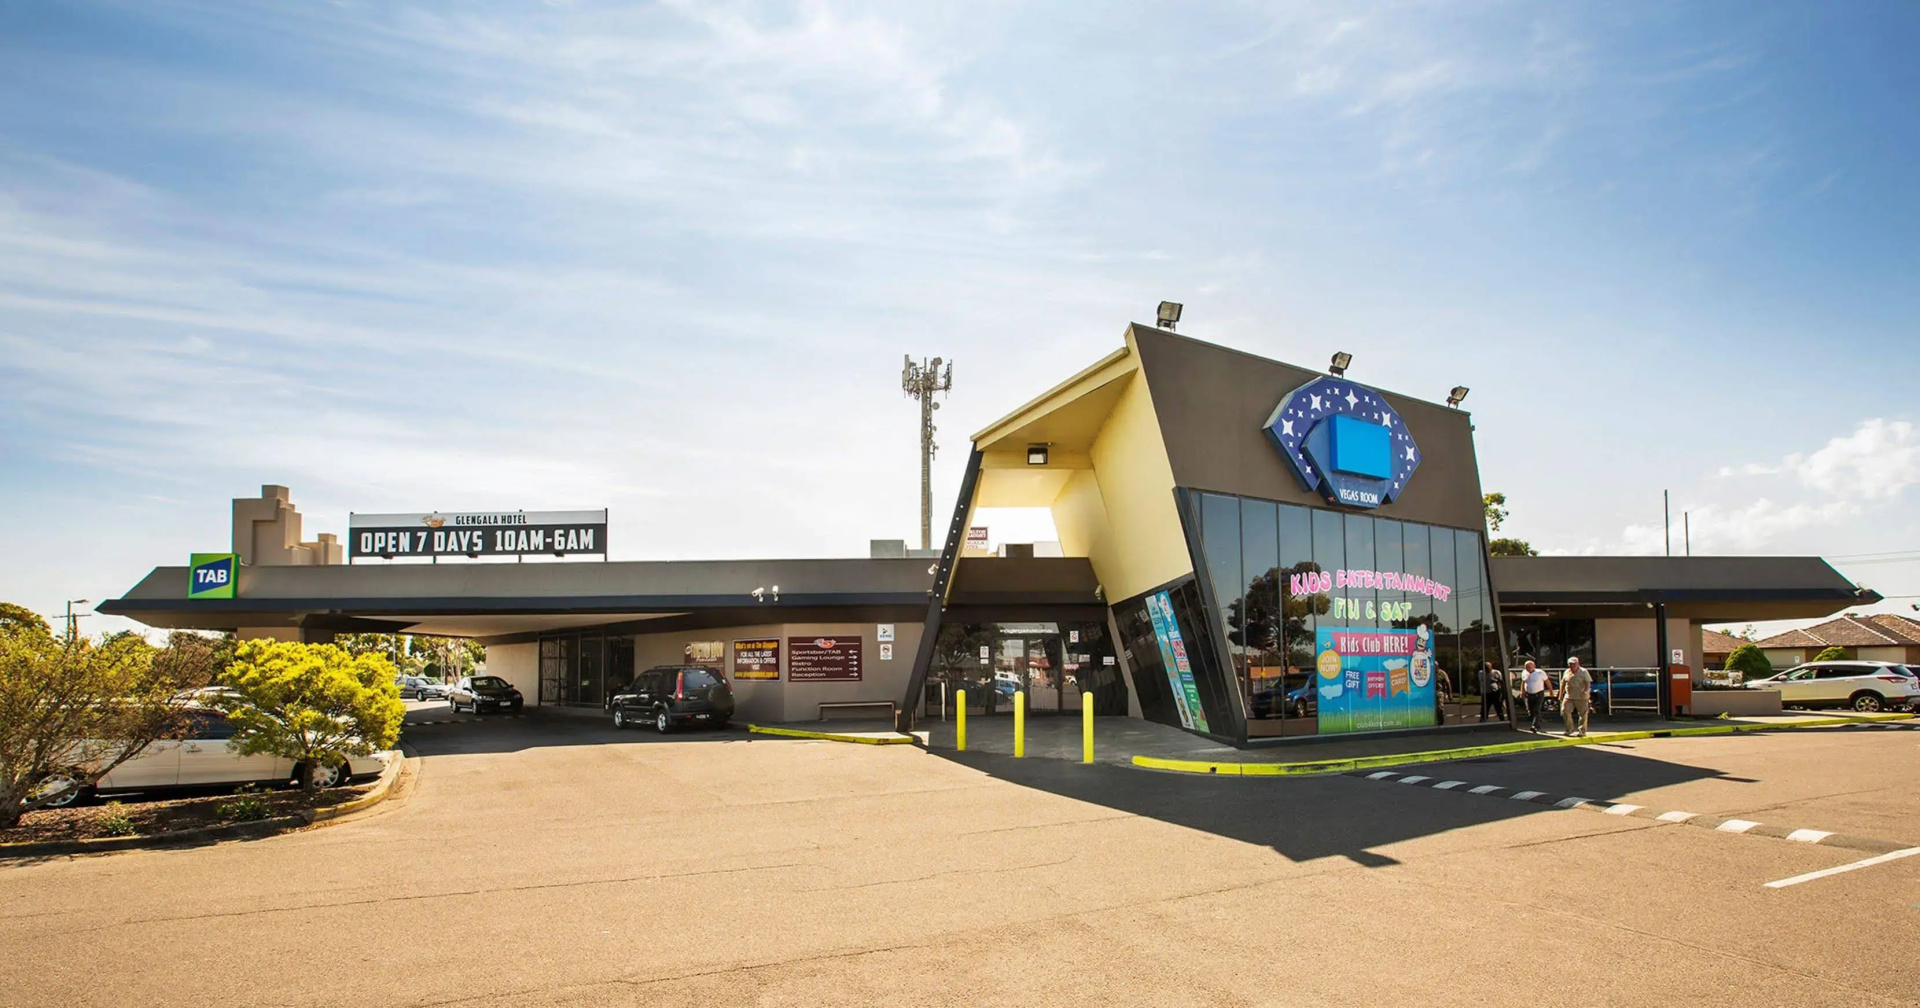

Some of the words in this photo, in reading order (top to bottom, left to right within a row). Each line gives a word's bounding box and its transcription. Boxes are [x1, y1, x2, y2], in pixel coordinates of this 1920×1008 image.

[1339, 488, 1359, 501] VEGAS
[1360, 491, 1378, 504] ROOM
[456, 515, 498, 525] GLENGALA
[501, 515, 527, 524] HOTEL
[361, 531, 411, 553] OPEN
[416, 531, 428, 552] 7
[433, 530, 483, 552] DAYS
[495, 529, 594, 551] 10AM-6AM
[196, 569, 227, 583] TAB
[1290, 571, 1332, 595] KIDS
[1336, 570, 1451, 602] ENTERTAINMENT
[1334, 597, 1360, 619] FRI
[1365, 601, 1376, 619] &
[1380, 601, 1412, 621] SAT
[1340, 636, 1359, 653] Kids
[1362, 636, 1381, 653] Club
[1383, 635, 1409, 653] HERE!
[1321, 654, 1337, 664] JOIN
[1345, 670, 1360, 680] FREE
[1345, 680, 1360, 689] GIFT
